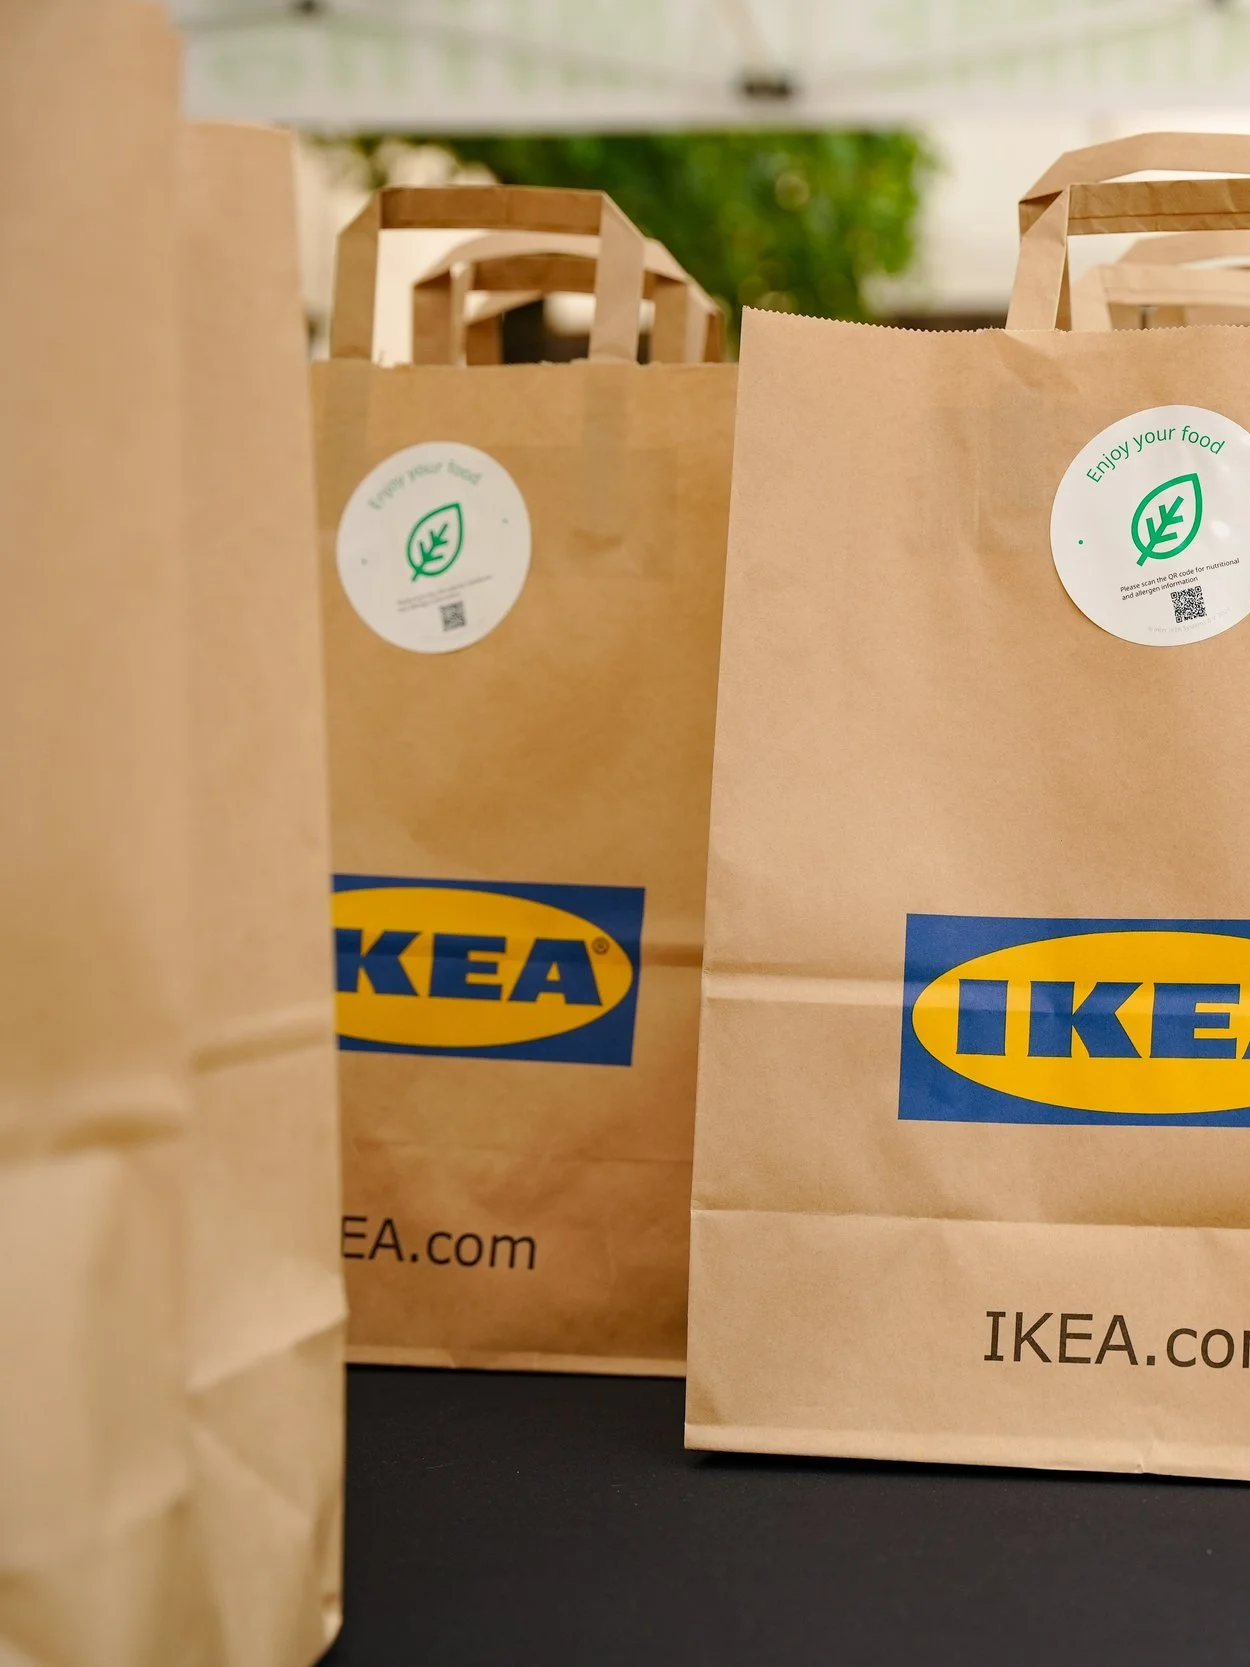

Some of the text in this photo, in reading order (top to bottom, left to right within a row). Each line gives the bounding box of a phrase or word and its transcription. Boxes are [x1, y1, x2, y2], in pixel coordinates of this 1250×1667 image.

[1086, 425, 1225, 483] Enjoy your food
[1120, 558, 1240, 593] Please scan the QR code for nutritional
[1121, 576, 1198, 601] and allergen information
[341, 1215, 536, 1270] EA.com
